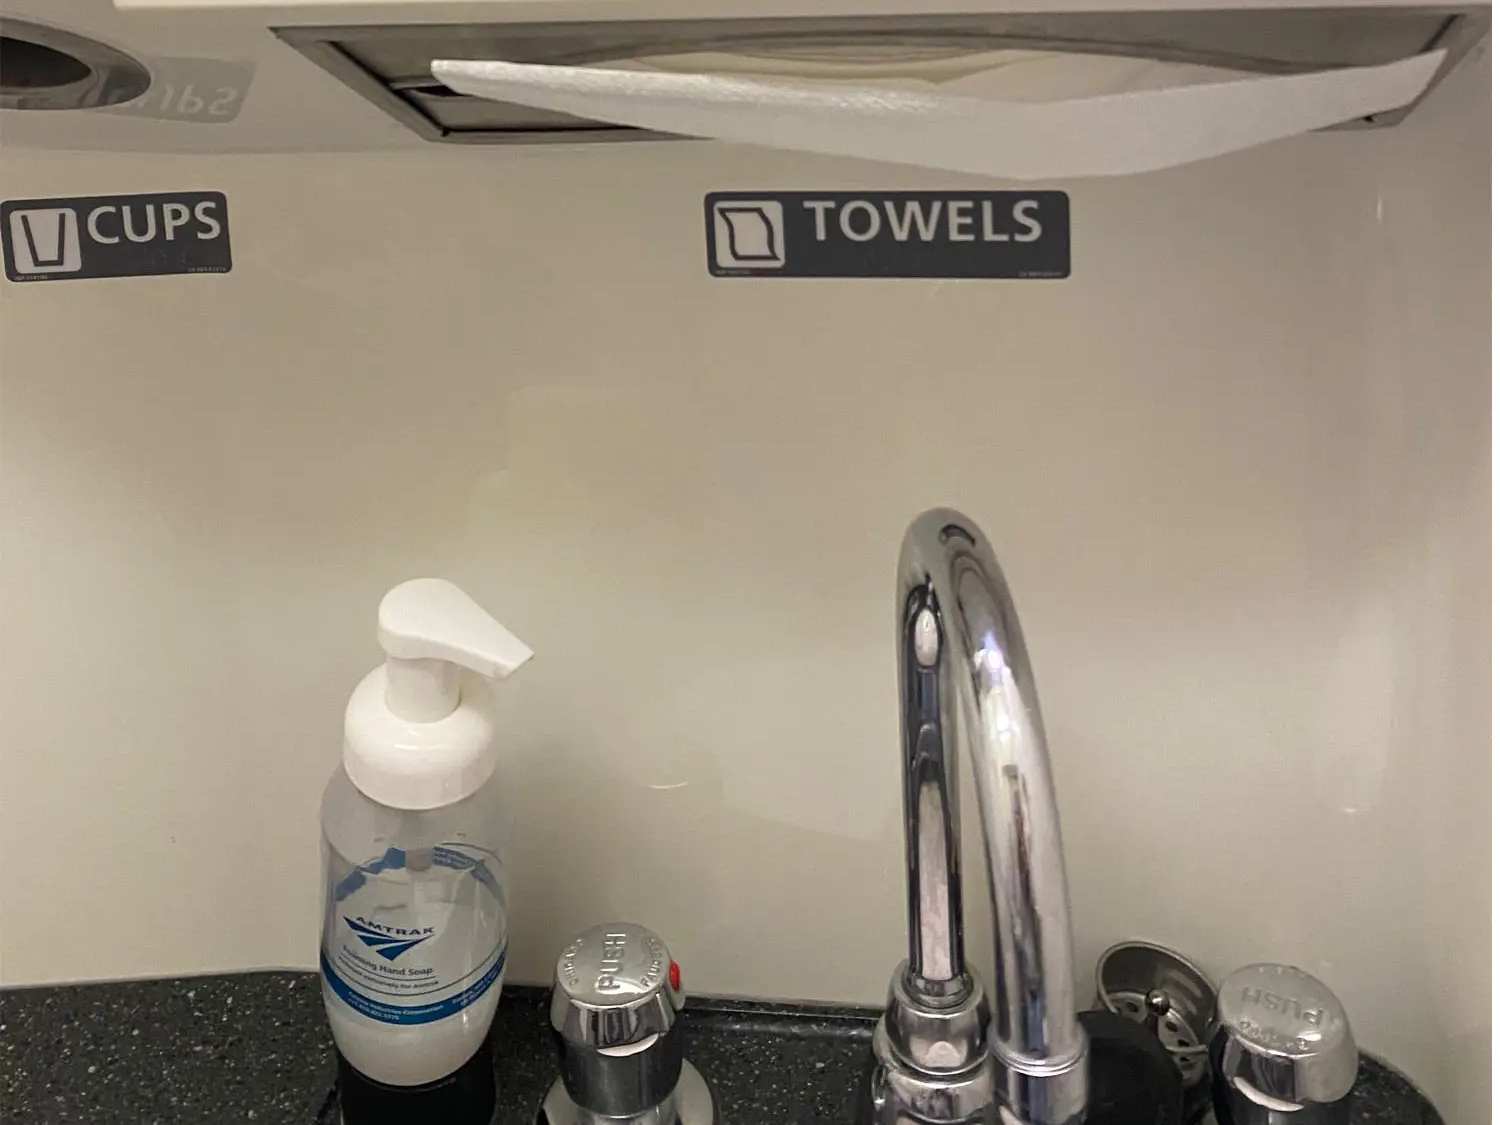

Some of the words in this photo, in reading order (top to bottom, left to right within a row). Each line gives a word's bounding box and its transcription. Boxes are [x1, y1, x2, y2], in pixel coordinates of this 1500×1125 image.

[87, 201, 221, 245] CUPS
[803, 200, 1043, 242] TOWELS
[356, 916, 435, 936] AMTRAK
[379, 963, 406, 976] Hand
[408, 966, 434, 977] Soap
[596, 932, 627, 989] PUSH
[1240, 985, 1325, 1027] PUSH
